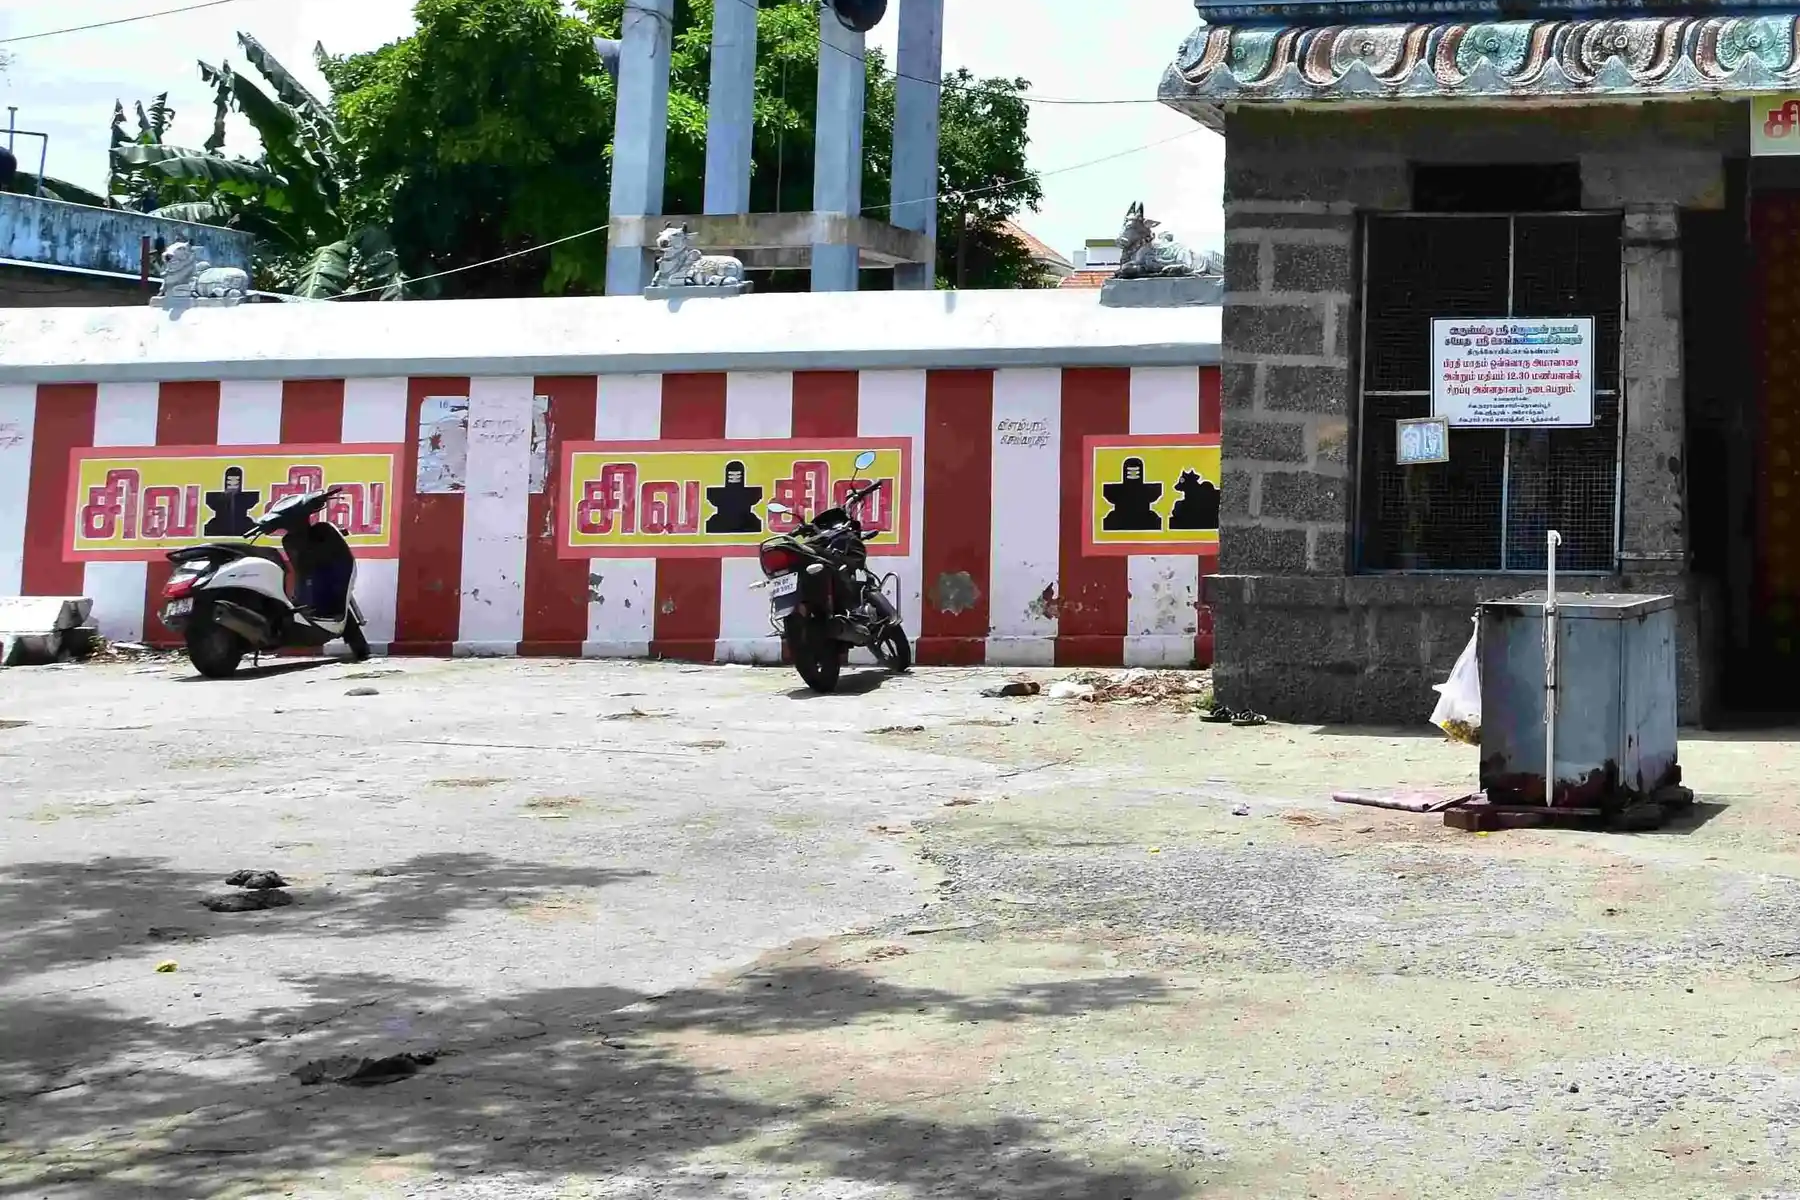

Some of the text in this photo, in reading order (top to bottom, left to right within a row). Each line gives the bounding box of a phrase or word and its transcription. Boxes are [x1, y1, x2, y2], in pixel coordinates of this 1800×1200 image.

[1443, 357, 1579, 370] பிரதி மாதம் ஒவ்வொரு அமாவாசை
[1443, 370, 1475, 383] அன்றும்
[1507, 372, 1530, 381] 12.30
[1472, 384, 1524, 395] அன்னதானம்
[81, 469, 200, 540] சிவ
[577, 461, 701, 535] சிவ
